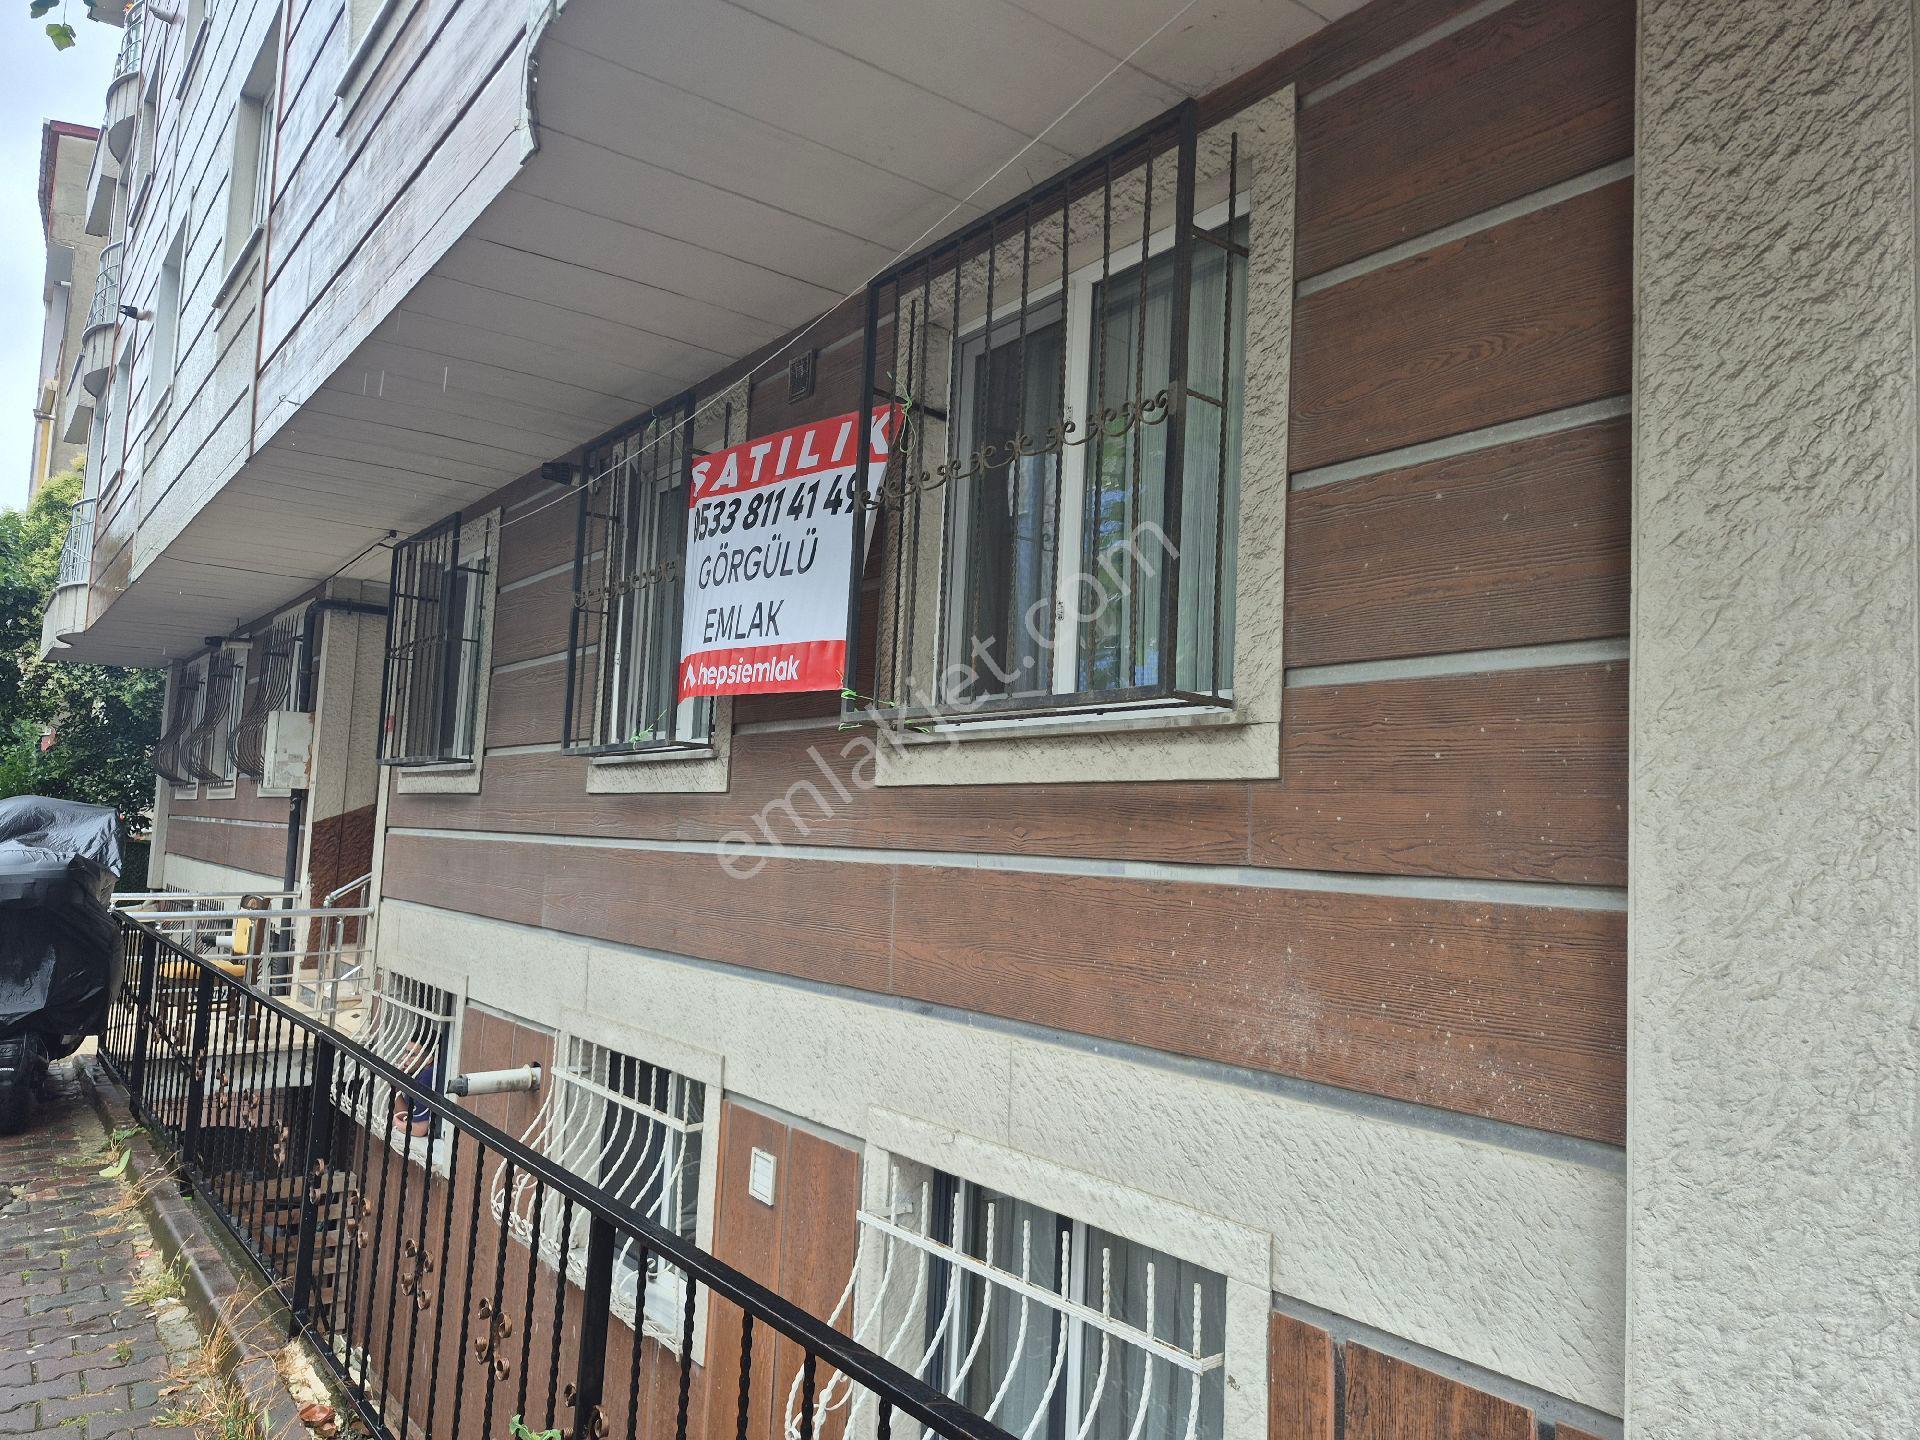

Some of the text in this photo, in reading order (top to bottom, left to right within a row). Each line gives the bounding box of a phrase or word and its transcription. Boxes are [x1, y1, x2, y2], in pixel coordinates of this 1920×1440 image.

[692, 411, 890, 497] SATILIK
[742, 487, 786, 531] 811
[787, 479, 820, 521] 41
[699, 528, 818, 590] GÖRGÜLÜ
[703, 600, 784, 644] EMLAK
[697, 655, 800, 690] hepsiemlak
